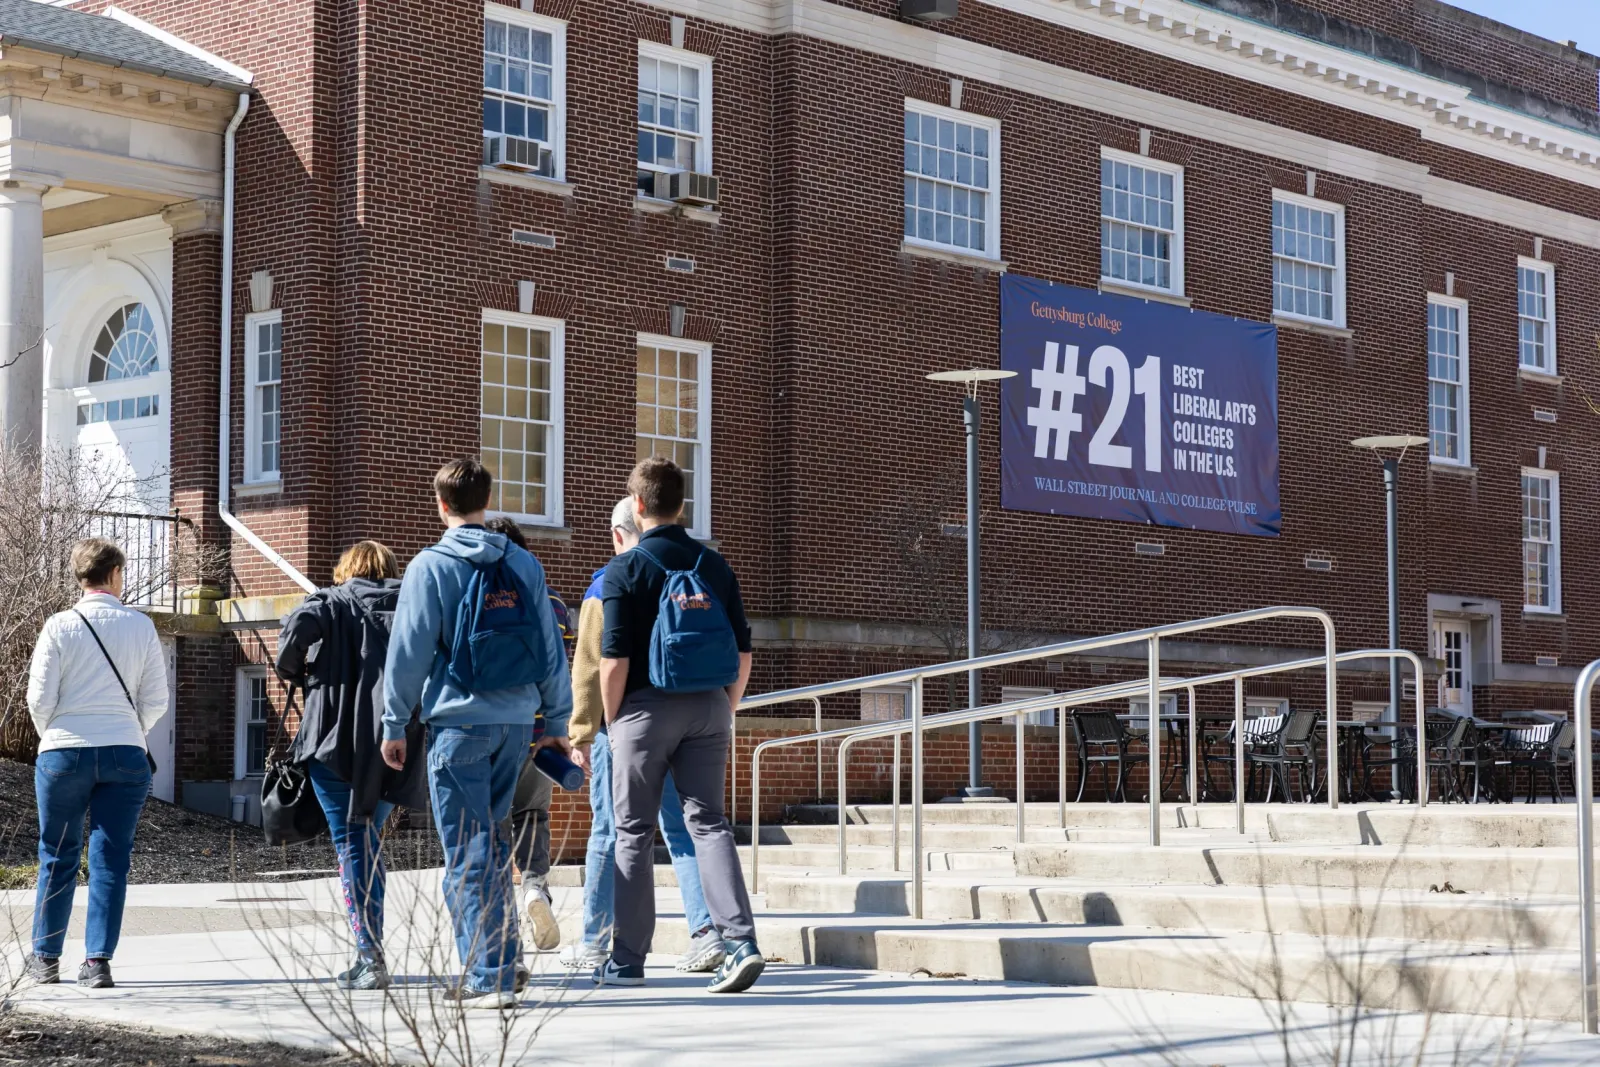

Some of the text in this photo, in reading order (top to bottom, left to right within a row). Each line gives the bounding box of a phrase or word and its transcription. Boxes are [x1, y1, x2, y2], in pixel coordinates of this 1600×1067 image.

[1031, 301, 1122, 334] Gettysburg College
[1173, 364, 1204, 389] BEST
[1027, 341, 1161, 472] #21
[1173, 392, 1256, 425] LIBERAL ARTS
[1173, 420, 1233, 449] COLLEGES
[1173, 448, 1237, 477] IN THE U.S.
[1034, 476, 1257, 514] WALL STREET JOURNAL AND COLLEGE PULSE
